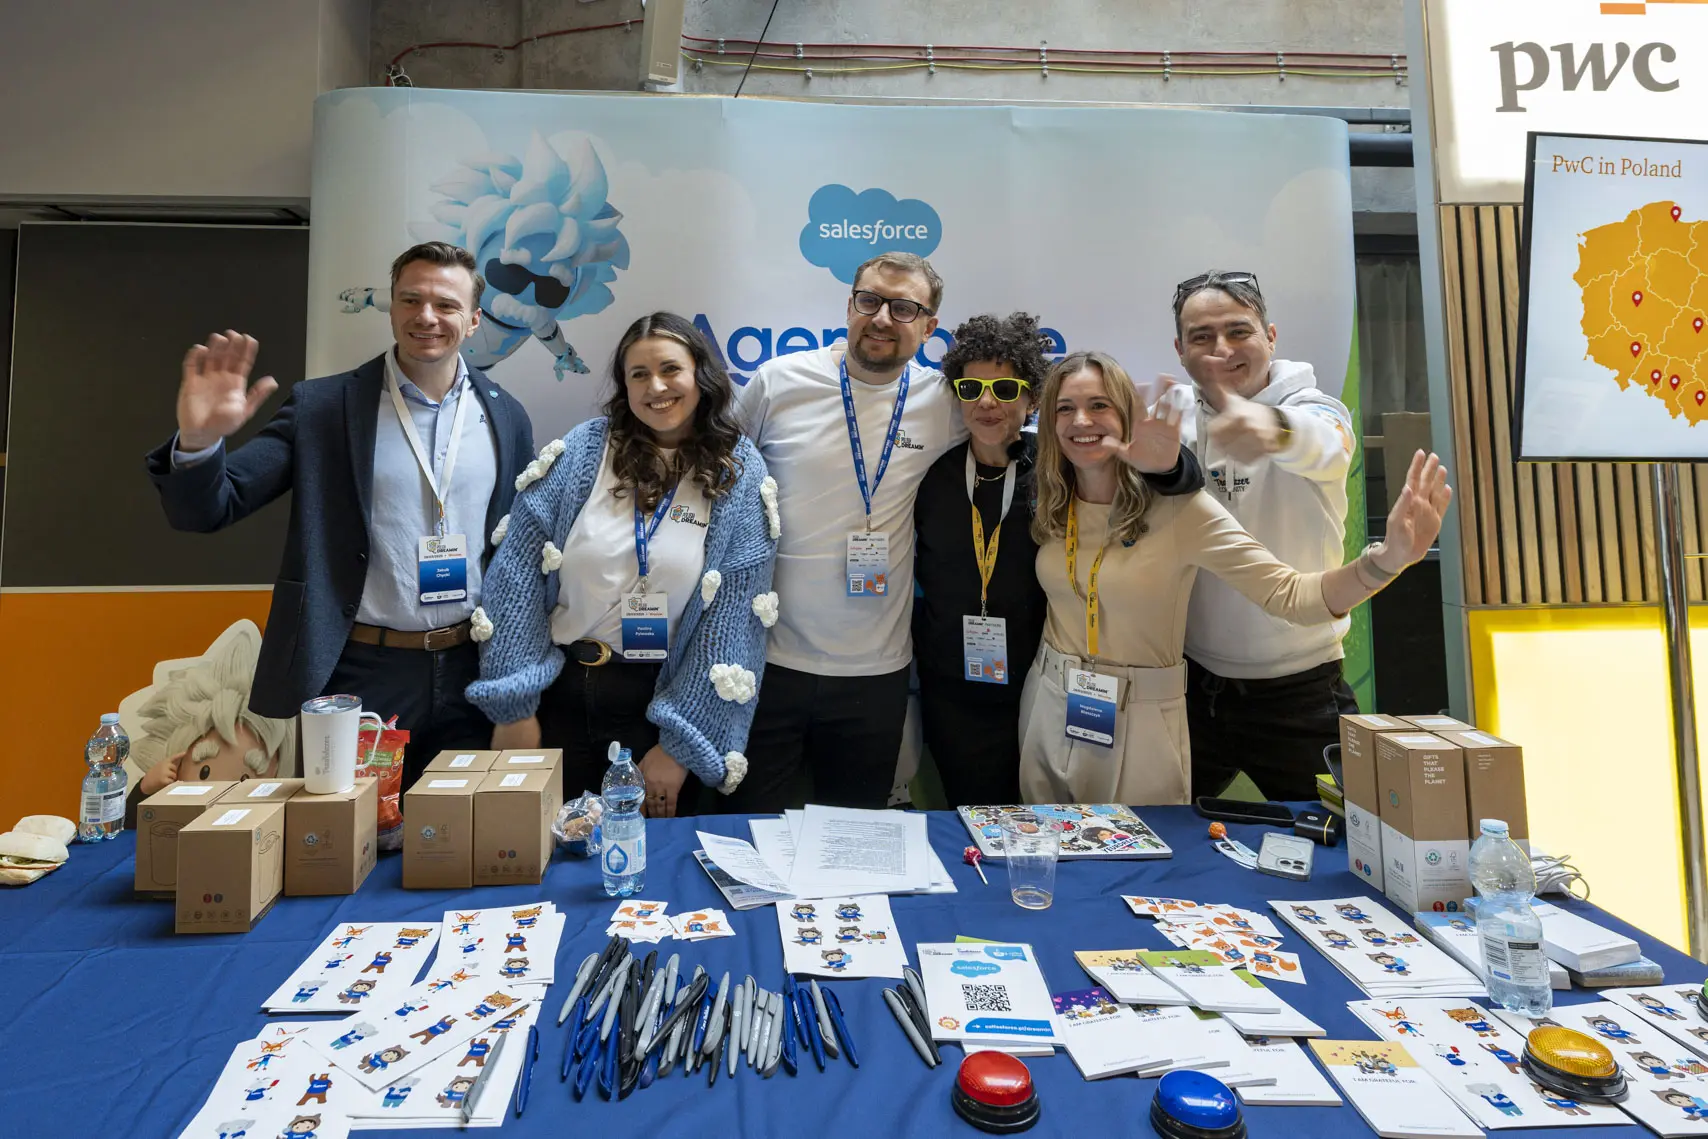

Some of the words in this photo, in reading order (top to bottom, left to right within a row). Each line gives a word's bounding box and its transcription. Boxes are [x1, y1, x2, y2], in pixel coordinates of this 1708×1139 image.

[1490, 41, 1680, 112] pwc
[1552, 155, 1594, 175] PwC
[1599, 157, 1616, 175] in
[1621, 158, 1682, 178] Poland
[819, 219, 928, 245] salesforce
